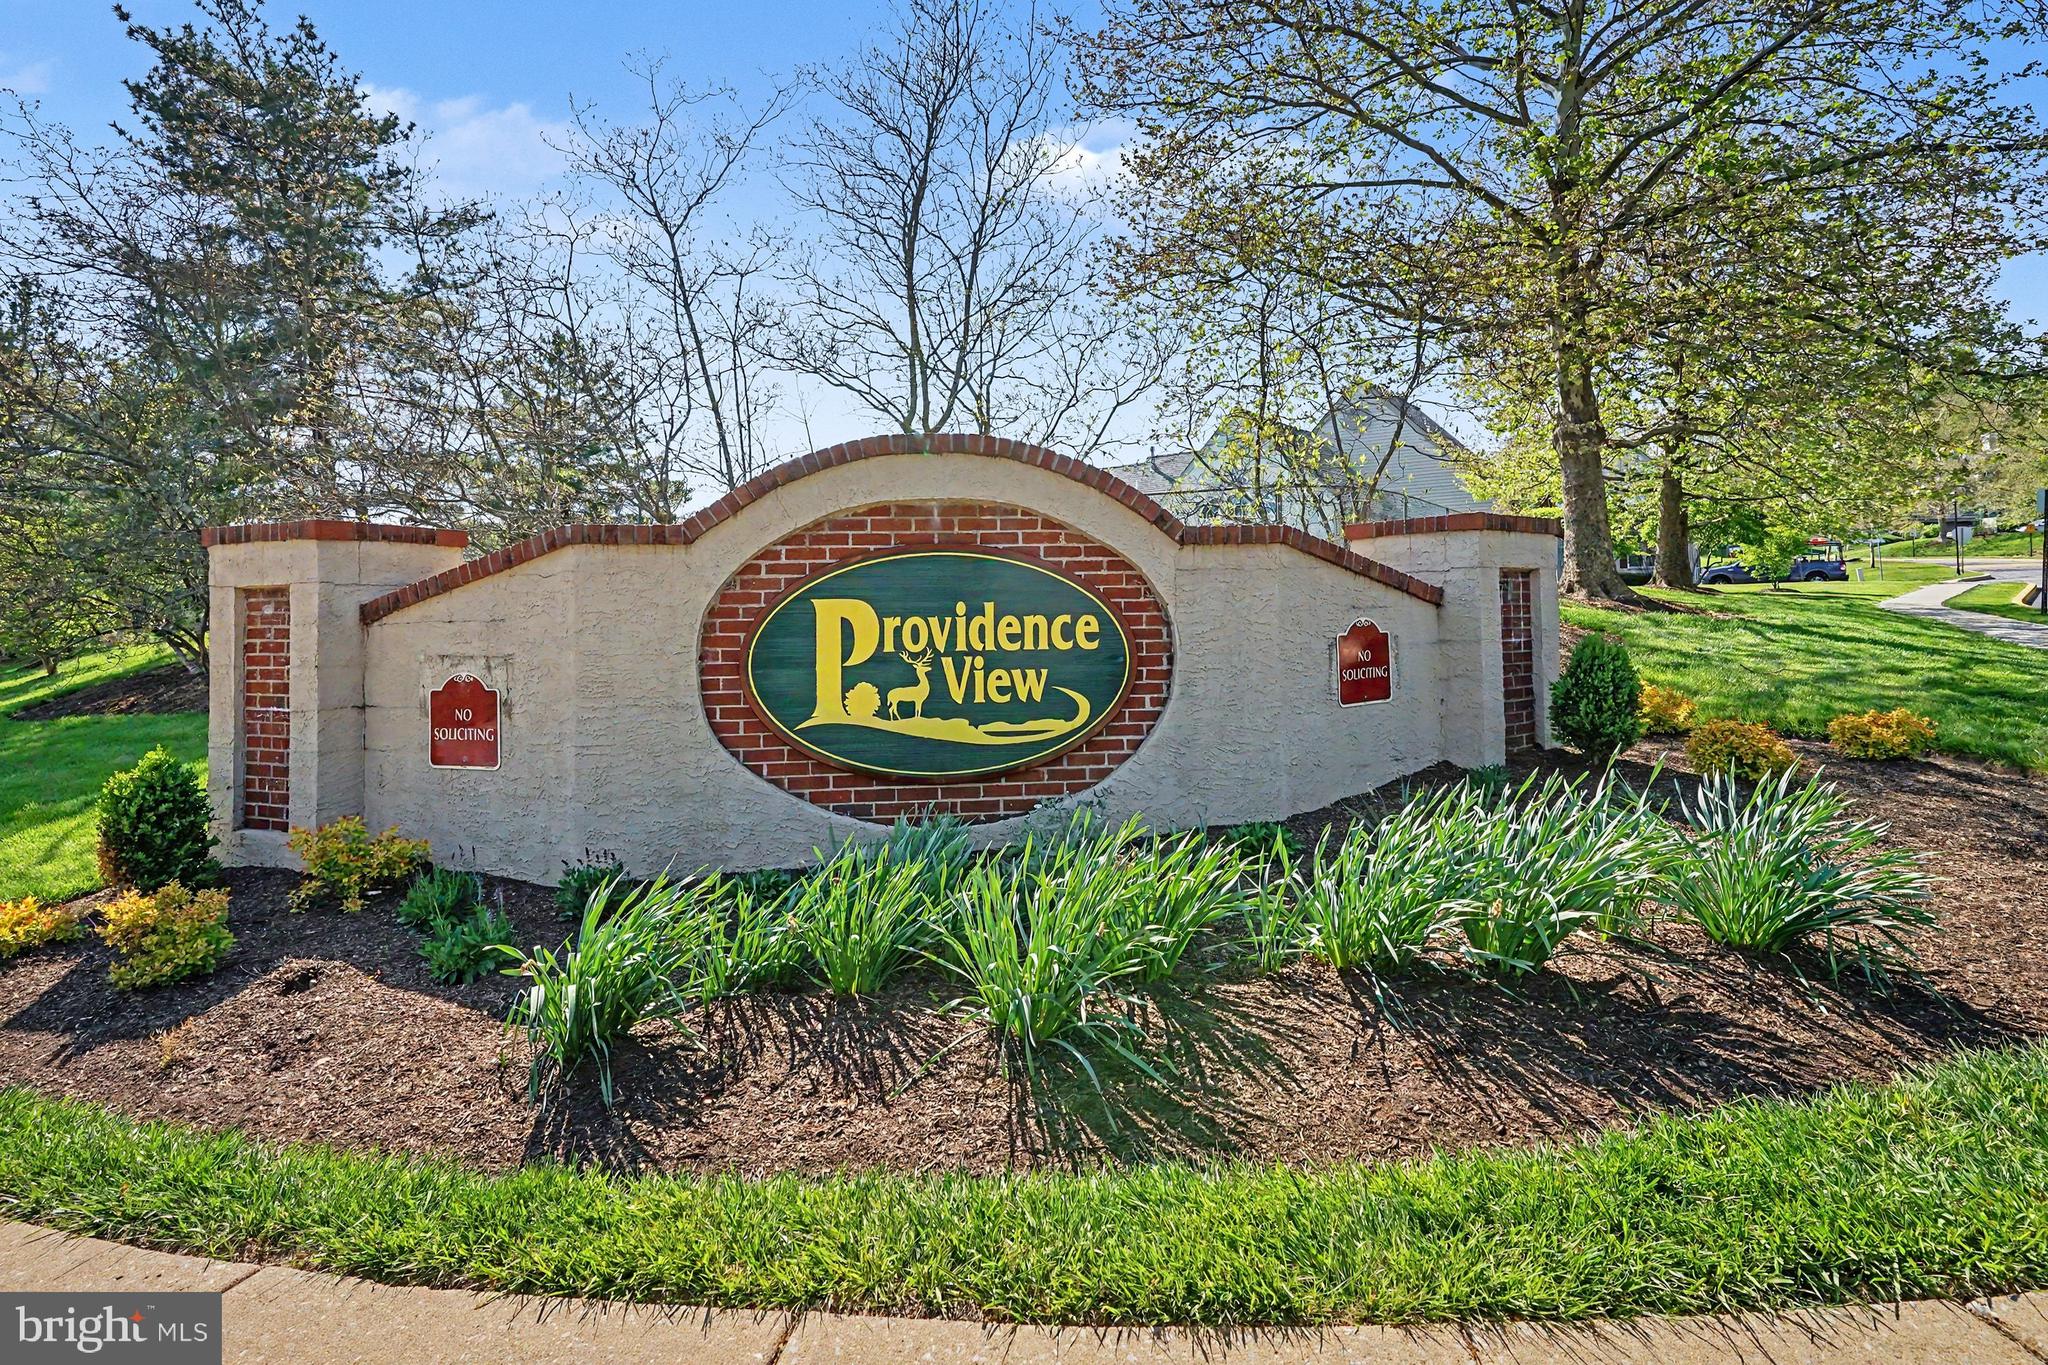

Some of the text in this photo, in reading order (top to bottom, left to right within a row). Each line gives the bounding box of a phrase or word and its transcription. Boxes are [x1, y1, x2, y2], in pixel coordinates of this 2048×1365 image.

[810, 598, 1100, 718] Providence
[1357, 649, 1371, 662] NO
[940, 656, 1049, 705] View
[1342, 665, 1388, 681] SOLICITING
[454, 708, 472, 721] NO
[434, 727, 494, 742] SOLICITING
